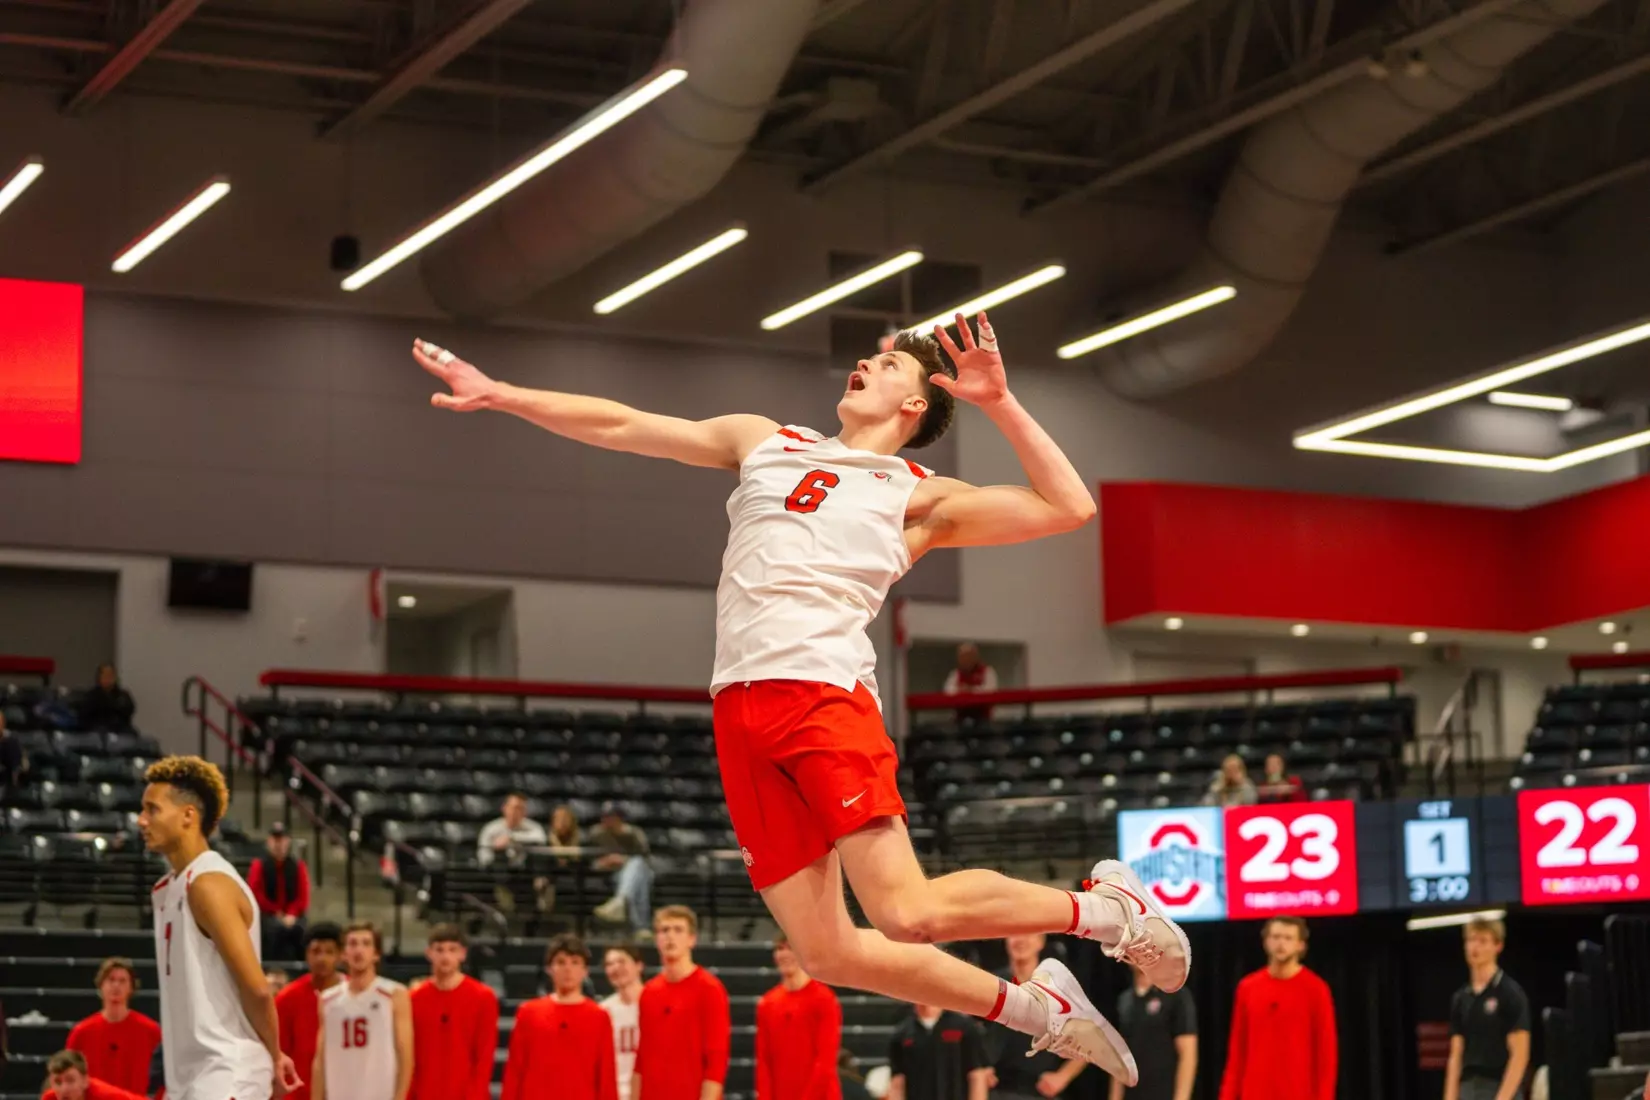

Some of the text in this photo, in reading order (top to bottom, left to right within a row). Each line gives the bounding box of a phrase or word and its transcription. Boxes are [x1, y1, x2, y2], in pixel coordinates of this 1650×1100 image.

[784, 469, 840, 513] 6
[1418, 801, 1453, 818] SET
[1239, 813, 1340, 882] 23
[1429, 832, 1445, 865] 1
[1534, 797, 1639, 868] 22
[1410, 876, 1468, 902] 3:00
[342, 1016, 368, 1049] 16
